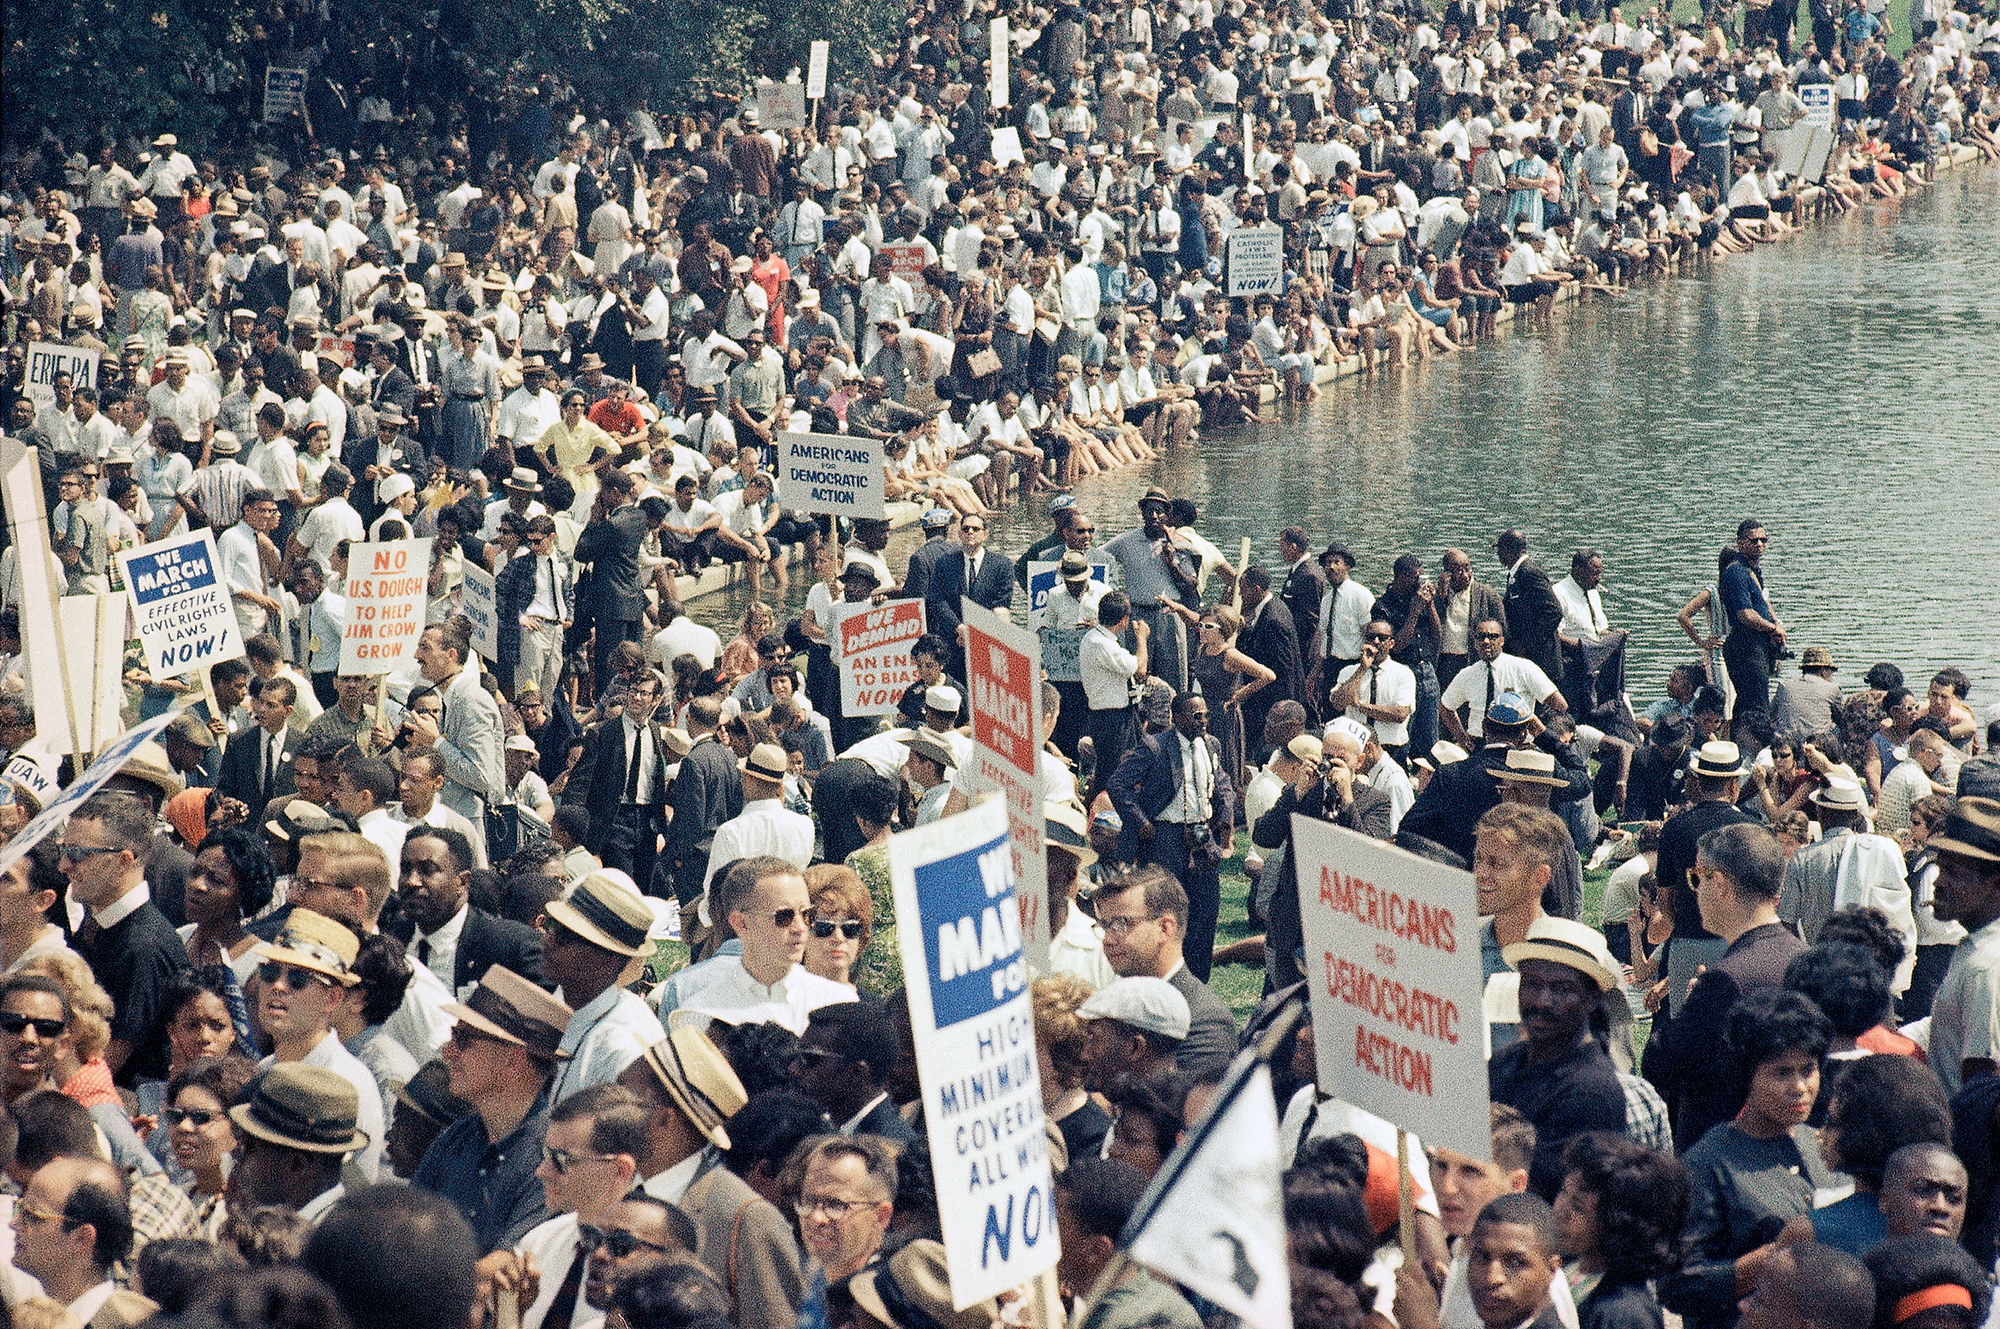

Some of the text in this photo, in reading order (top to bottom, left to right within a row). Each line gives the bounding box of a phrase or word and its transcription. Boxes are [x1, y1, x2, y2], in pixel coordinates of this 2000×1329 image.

[1236, 276, 1278, 290] NOW!
[71, 356, 91, 389] PA
[790, 443, 870, 464] AMERICANS
[790, 467, 869, 488] DEMOCRATIC
[811, 487, 855, 504] ACTION
[154, 549, 181, 568] WE
[374, 549, 408, 571] NO
[137, 558, 209, 593] MARCH
[162, 582, 191, 597] FOR
[350, 577, 424, 599] U.S. DOUGH
[148, 591, 217, 619] EFFECTIVE
[356, 603, 413, 621] TO HELP
[141, 602, 227, 635] CIVIL RIGHTS
[866, 607, 897, 629] WE
[167, 622, 207, 642] LAWS
[344, 621, 417, 639] JIM CROW
[846, 618, 920, 652] DEMAND
[161, 628, 228, 669] NOW!
[356, 642, 403, 659] GROW
[852, 656, 877, 670] AN
[988, 643, 1010, 684] WE
[853, 669, 922, 686] TO BIAS
[973, 672, 1029, 739] MARCH
[10, 762, 49, 792] UAW
[1319, 864, 1458, 955] AMERICANS
[1323, 950, 1459, 1046] DEMOCRATIC
[1355, 1023, 1433, 1098] ACTION
[969, 1152, 1007, 1192] ALL
